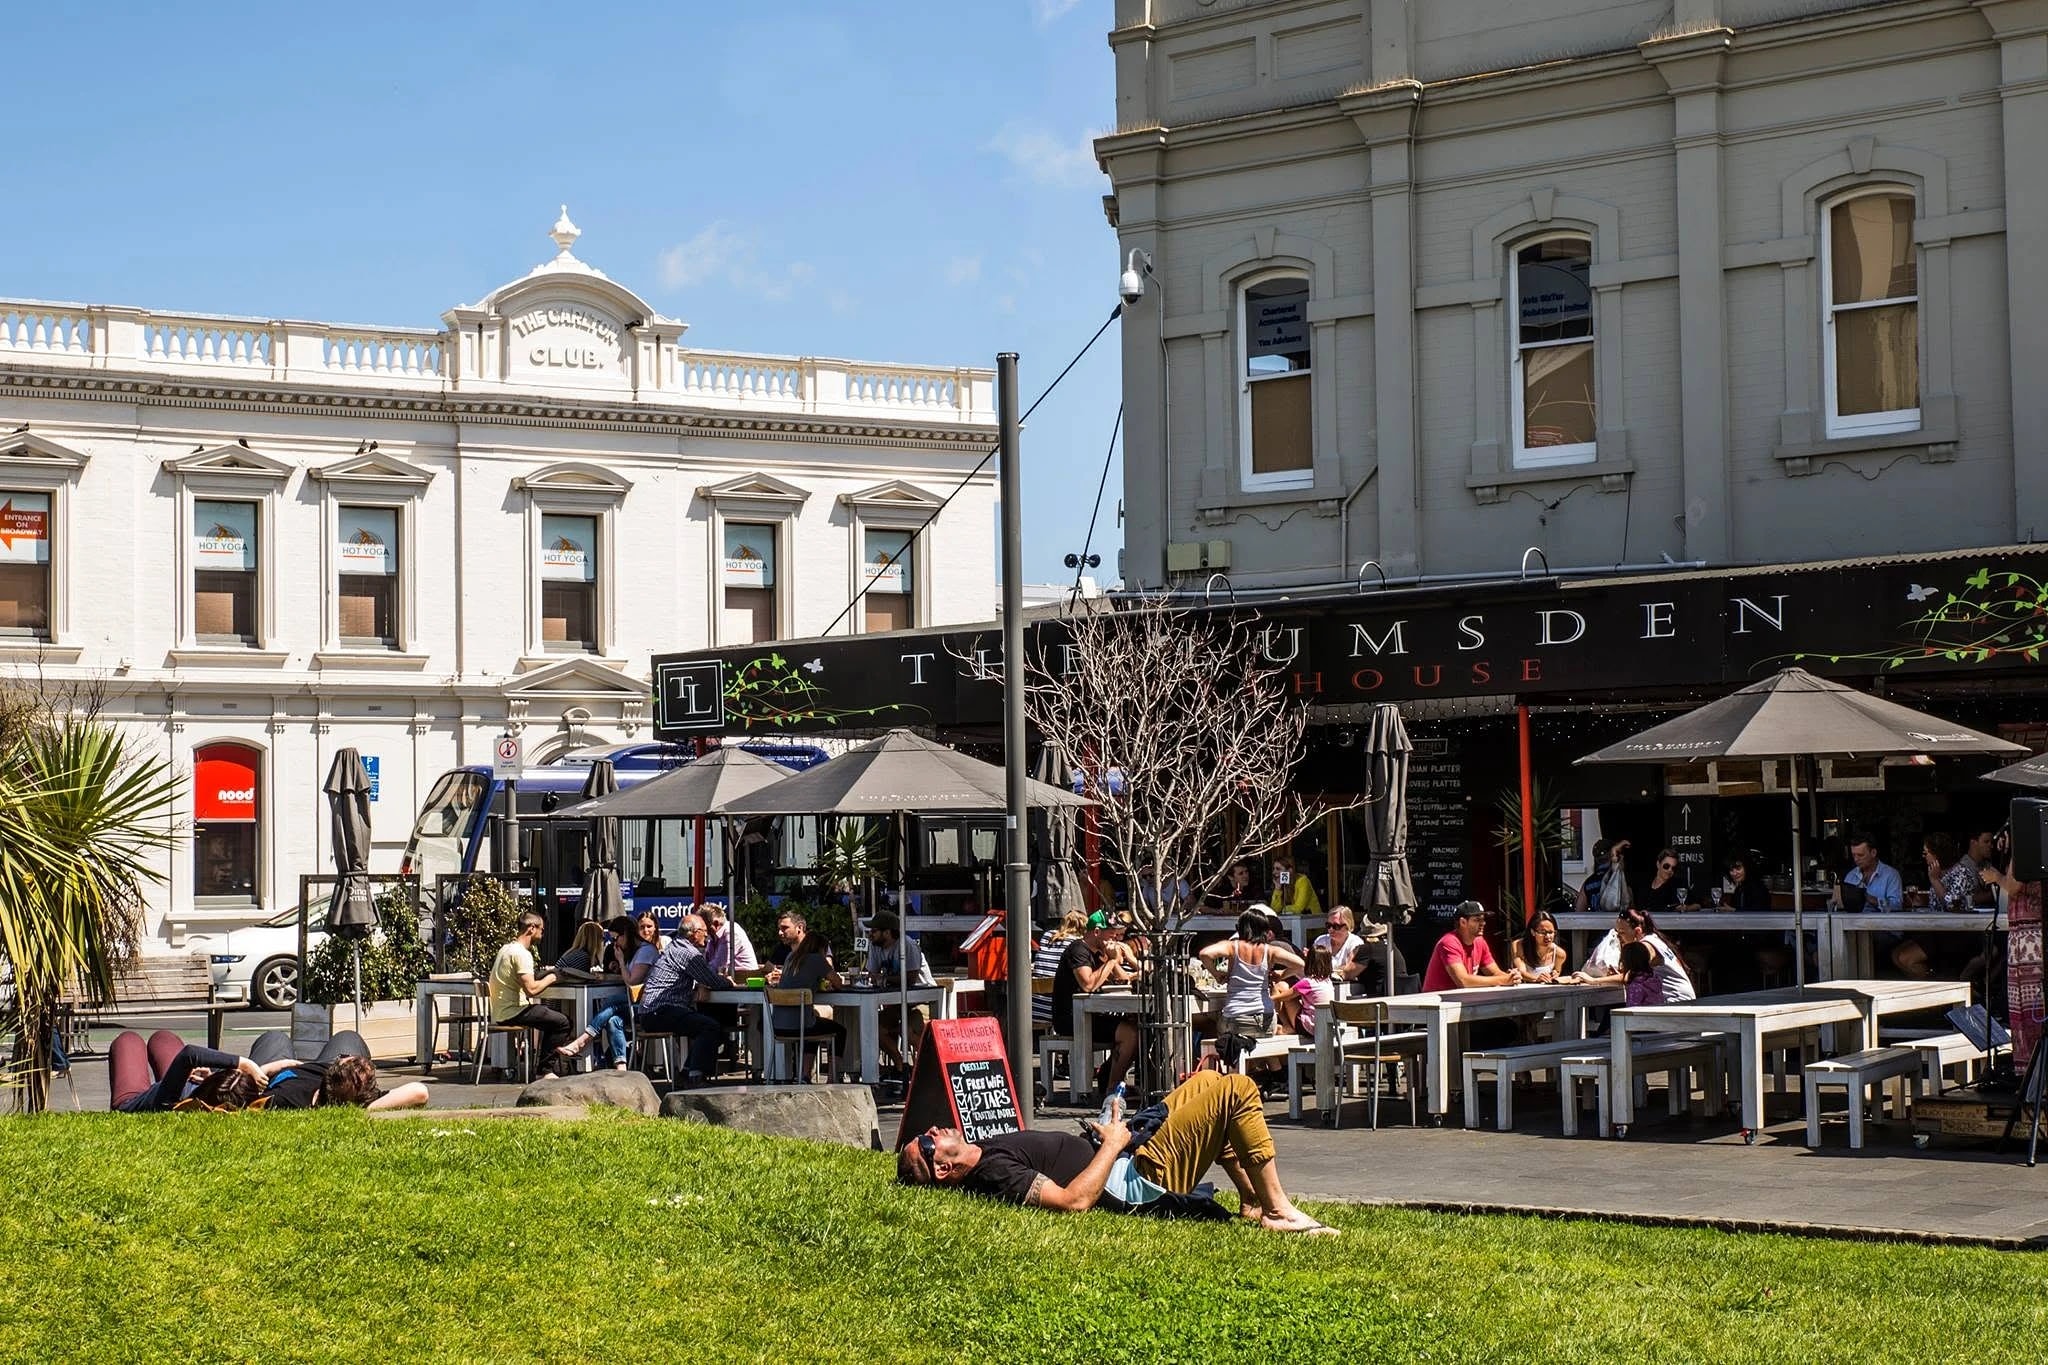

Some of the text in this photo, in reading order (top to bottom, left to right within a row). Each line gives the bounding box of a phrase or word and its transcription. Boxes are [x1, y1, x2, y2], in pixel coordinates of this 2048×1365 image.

[512, 310, 546, 338] THE
[4, 514, 42, 522] ENTRANCE
[16, 521, 28, 529] ON
[0, 527, 43, 536] BROADWAY
[199, 541, 248, 552] HOT YOGA
[342, 547, 390, 556] HOT YOGA
[544, 554, 588, 563] HOT YOGA
[726, 561, 768, 570] HOT YOGA
[1293, 657, 1545, 694] HOUSE
[218, 788, 255, 800] nood
[1671, 836, 1702, 846] BEERS
[1678, 853, 1705, 863] ENUS
[856, 939, 867, 949] 29
[941, 1025, 996, 1038] THE LUMSDEN
[949, 1041, 993, 1053] FREEHOUSE
[966, 1077, 985, 1091] FREE
[982, 1088, 1011, 1109] TAPS
